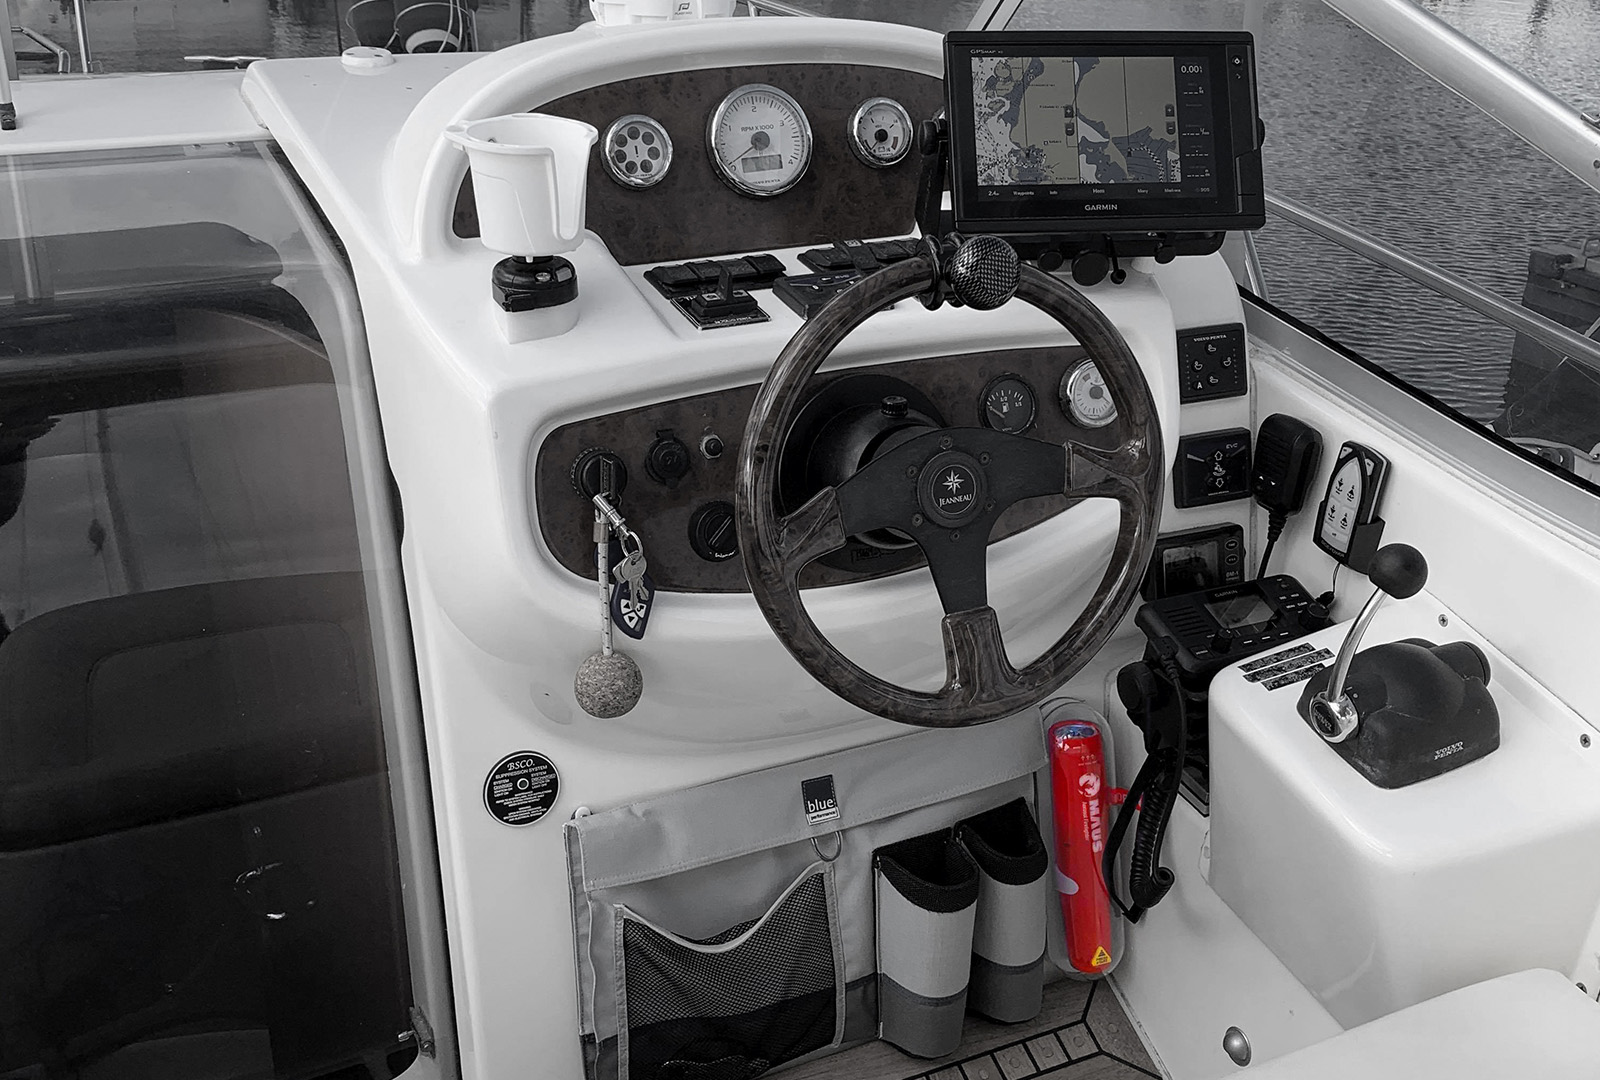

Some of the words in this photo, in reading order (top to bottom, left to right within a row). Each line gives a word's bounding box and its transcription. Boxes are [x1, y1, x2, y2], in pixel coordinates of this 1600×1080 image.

[939, 494, 972, 508] JEANNEAU
[1434, 746, 1464, 760] PENTA
[1435, 741, 1463, 754] VOLVO
[507, 759, 535, 770] BSCO.
[495, 769, 528, 779] SUPPRESSION
[808, 798, 834, 812] blue
[1089, 799, 1102, 853] MAUS
